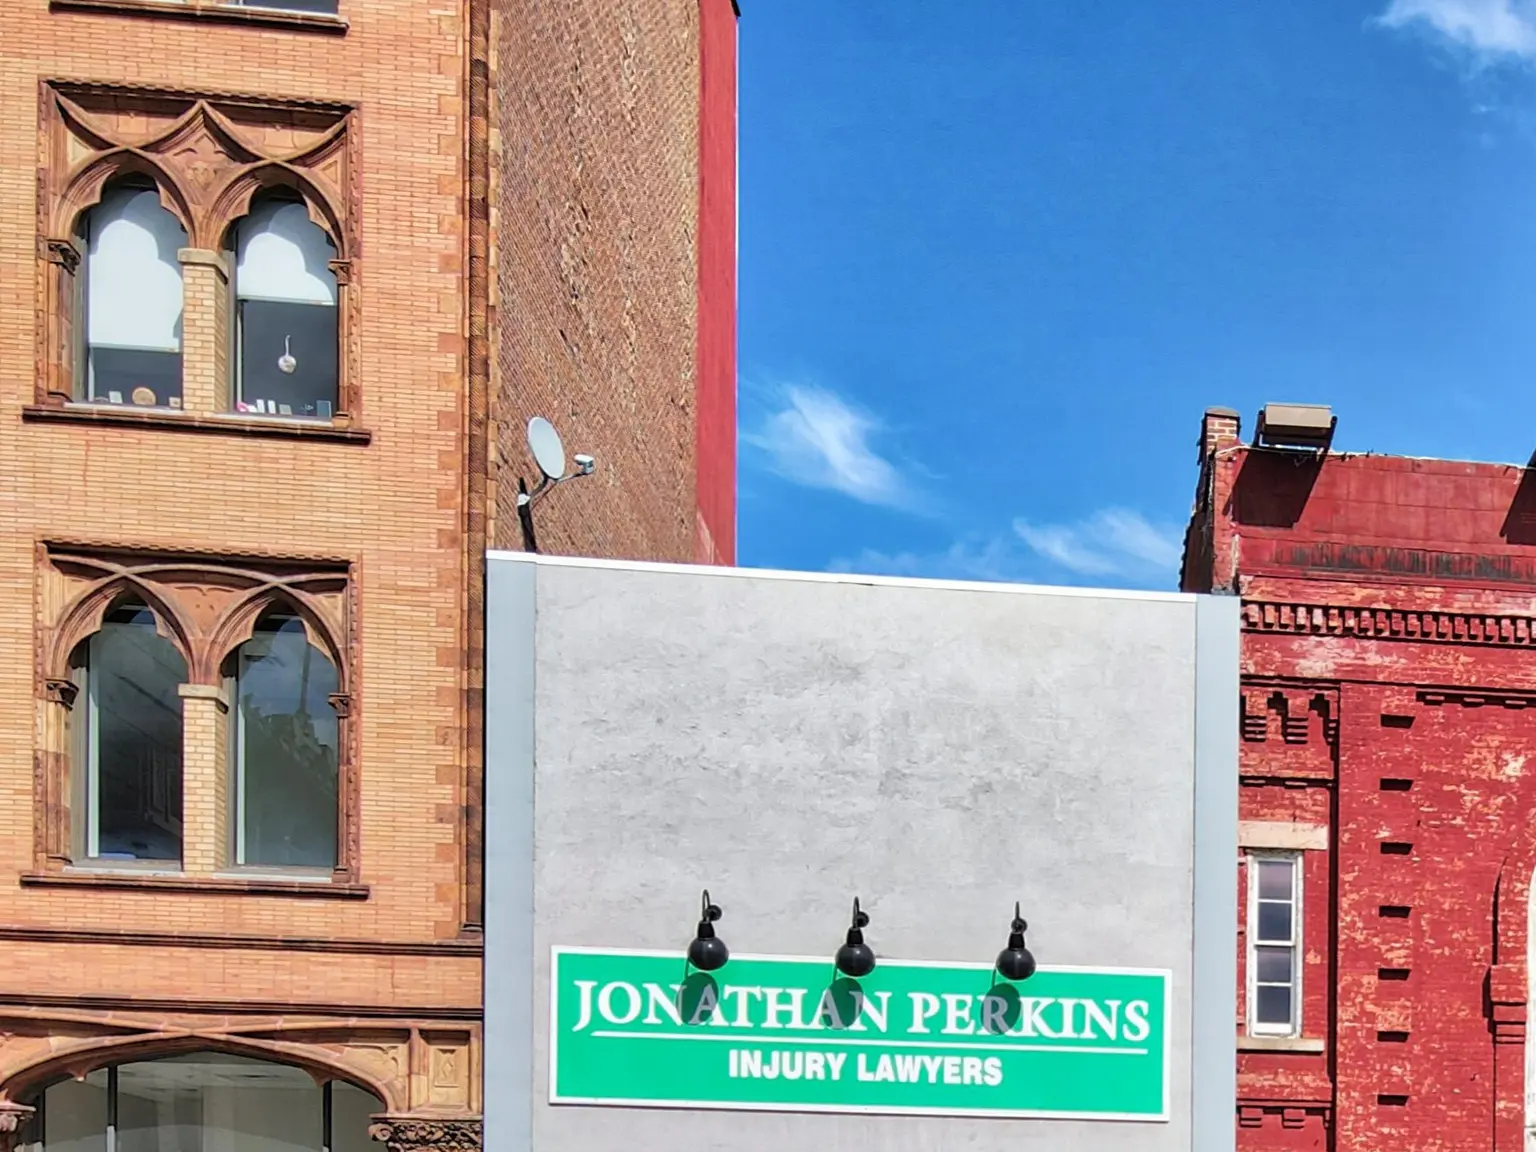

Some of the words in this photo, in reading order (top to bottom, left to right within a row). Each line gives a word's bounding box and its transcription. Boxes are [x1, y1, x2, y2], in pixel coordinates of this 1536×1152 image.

[572, 979, 893, 1033] JONATHAN
[906, 991, 1151, 1042] PERKINS
[728, 1048, 848, 1081] INJURY
[857, 1053, 1004, 1086] LAWYERS
